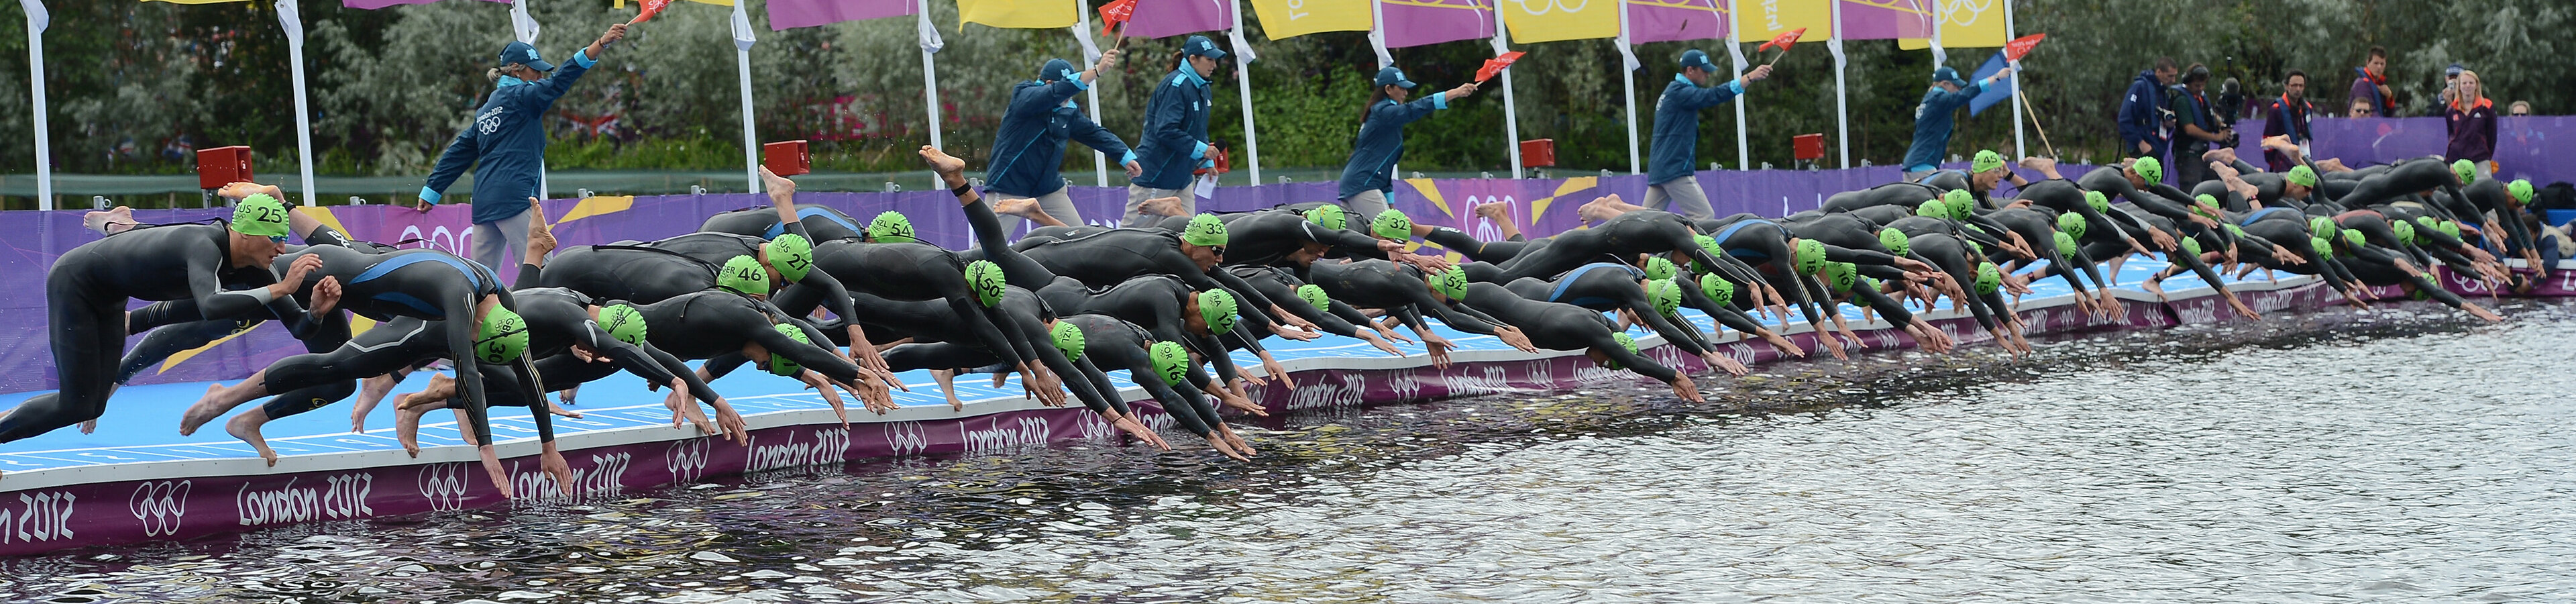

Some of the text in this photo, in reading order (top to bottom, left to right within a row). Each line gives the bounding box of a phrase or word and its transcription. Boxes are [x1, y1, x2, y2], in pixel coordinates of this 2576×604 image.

[491, 106, 502, 115] 2012
[257, 206, 282, 223] 25
[1957, 203, 1968, 217] 36
[890, 224, 911, 236] 54
[1205, 223, 1223, 235] 33
[1390, 217, 1407, 230] 32
[779, 237, 790, 253] RUS
[786, 254, 809, 270] 27
[1806, 259, 1816, 273] 18
[737, 268, 762, 281] 46
[1837, 270, 1850, 285] 10
[980, 278, 1000, 297] 50
[1446, 276, 1463, 291] 52
[1980, 280, 1990, 291] 15
[1212, 291, 1222, 307] FRA
[1306, 288, 1315, 305] USA
[1715, 289, 1729, 302] 49
[1660, 297, 1674, 314] 43
[1217, 312, 1233, 330] 12
[1061, 327, 1073, 343] NZL
[488, 341, 506, 362] 30
[1164, 343, 1173, 360] POR
[1166, 363, 1181, 381] 16
[1286, 373, 1365, 411] London 2012
[959, 417, 1018, 454] London
[745, 428, 851, 472] London 2012
[586, 451, 631, 491] 2012
[236, 472, 374, 525] London 2012
[18, 491, 76, 543] 2012
